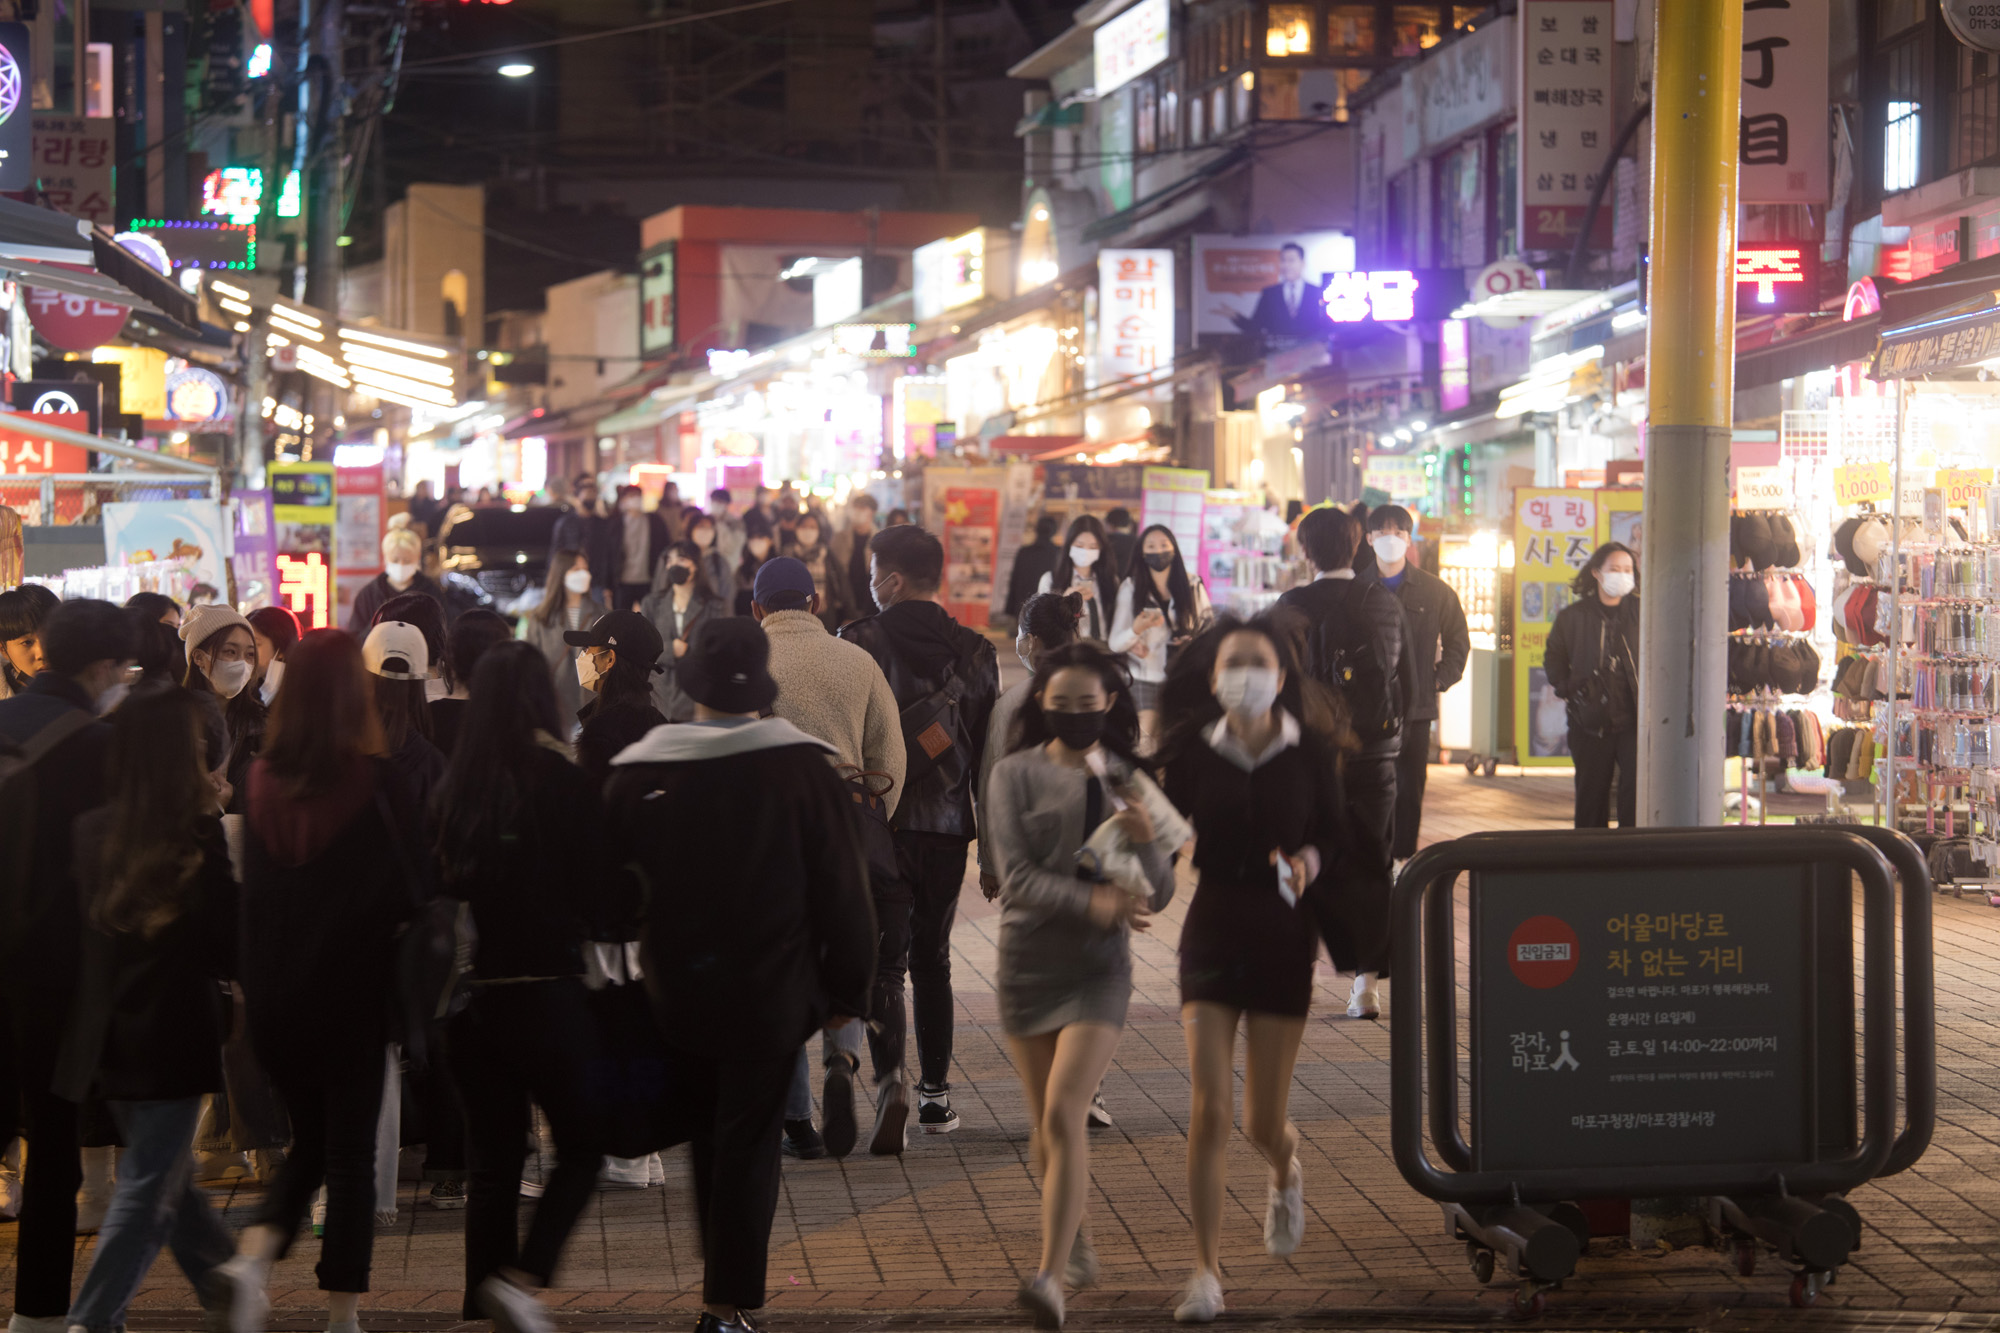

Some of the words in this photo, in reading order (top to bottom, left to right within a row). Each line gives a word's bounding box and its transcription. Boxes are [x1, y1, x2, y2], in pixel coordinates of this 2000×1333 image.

[1537, 46, 1602, 65] 순대국
[1539, 129, 1598, 149] 냉면
[33, 137, 108, 168] 라탕
[0, 440, 53, 475] 신
[1529, 499, 1586, 528] 힐링
[1523, 535, 1591, 567] 사주
[1606, 911, 1729, 942] 어울마당로
[1519, 944, 1568, 960] 진입금지
[1606, 948, 1632, 976] 차
[1640, 947, 1689, 977] 없는
[1698, 945, 1743, 974] 거리
[1606, 986, 1635, 998] 걸으면
[1681, 984, 1710, 996] 마포가
[1606, 1012, 1651, 1026] 운영시간
[1654, 1011, 1697, 1025] (요일제)
[1509, 1031, 1551, 1053] 걷자,
[1511, 1052, 1549, 1073] 마포
[1571, 1110, 1716, 1129] 마포구청장/마포경찰서장
